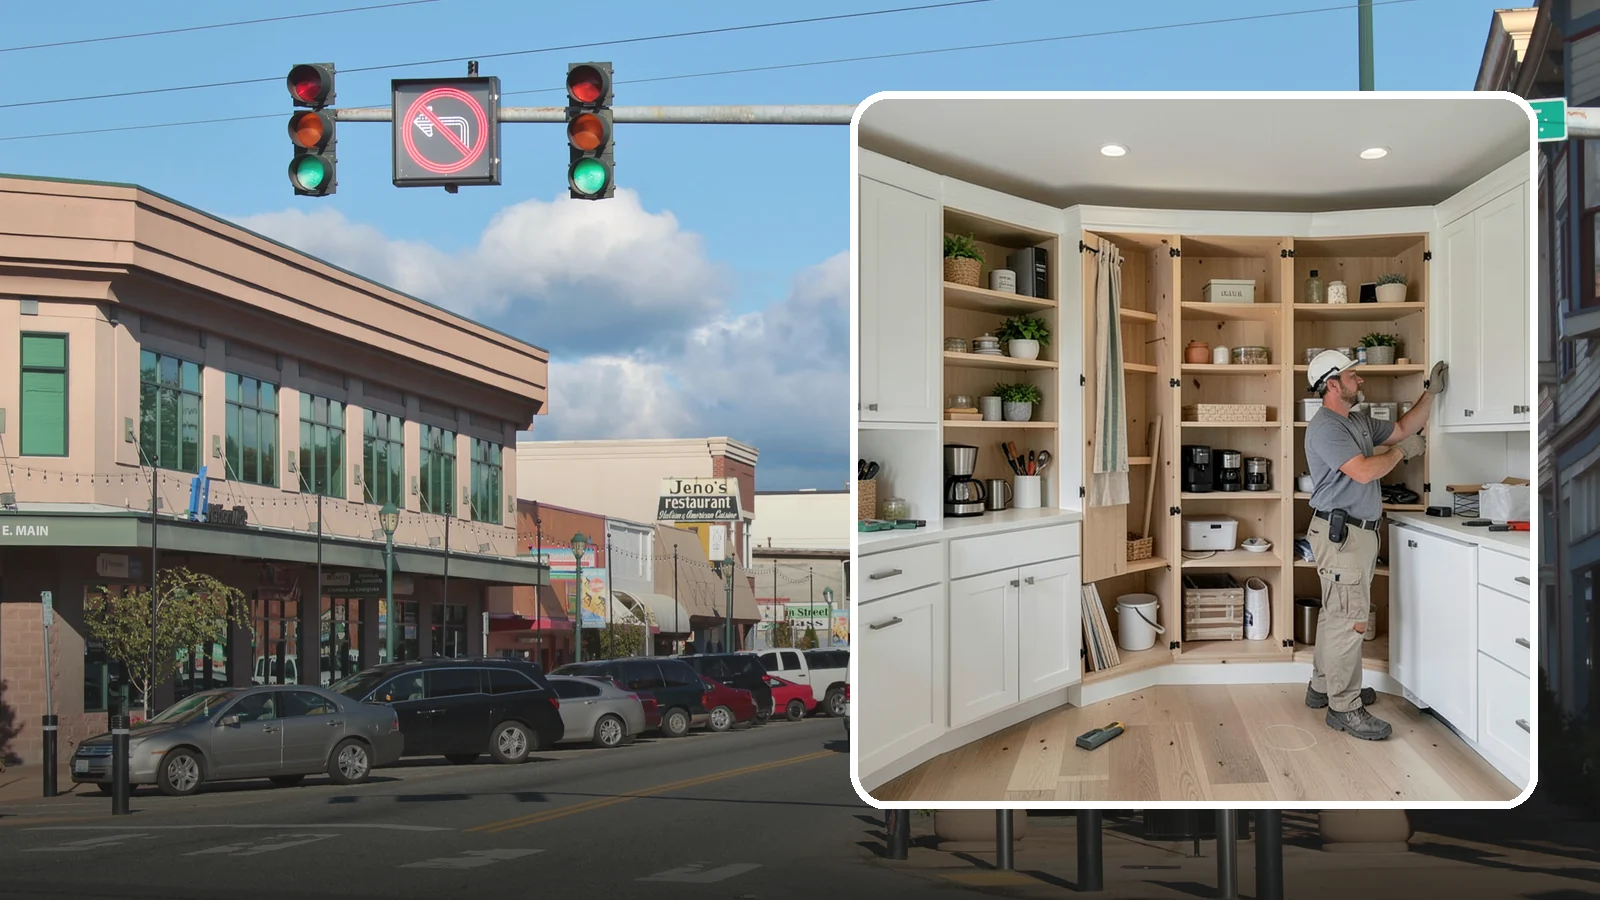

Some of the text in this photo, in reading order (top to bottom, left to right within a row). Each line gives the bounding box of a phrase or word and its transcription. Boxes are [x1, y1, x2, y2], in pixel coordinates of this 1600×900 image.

[669, 480, 728, 495] Jeno's
[665, 497, 731, 509] restaurant
[658, 510, 682, 520] Italian
[686, 510, 714, 519] American
[715, 509, 737, 519] Cuisine
[2, 525, 49, 536] E. MAIN
[797, 607, 828, 616] Street
[790, 619, 824, 627] lass
